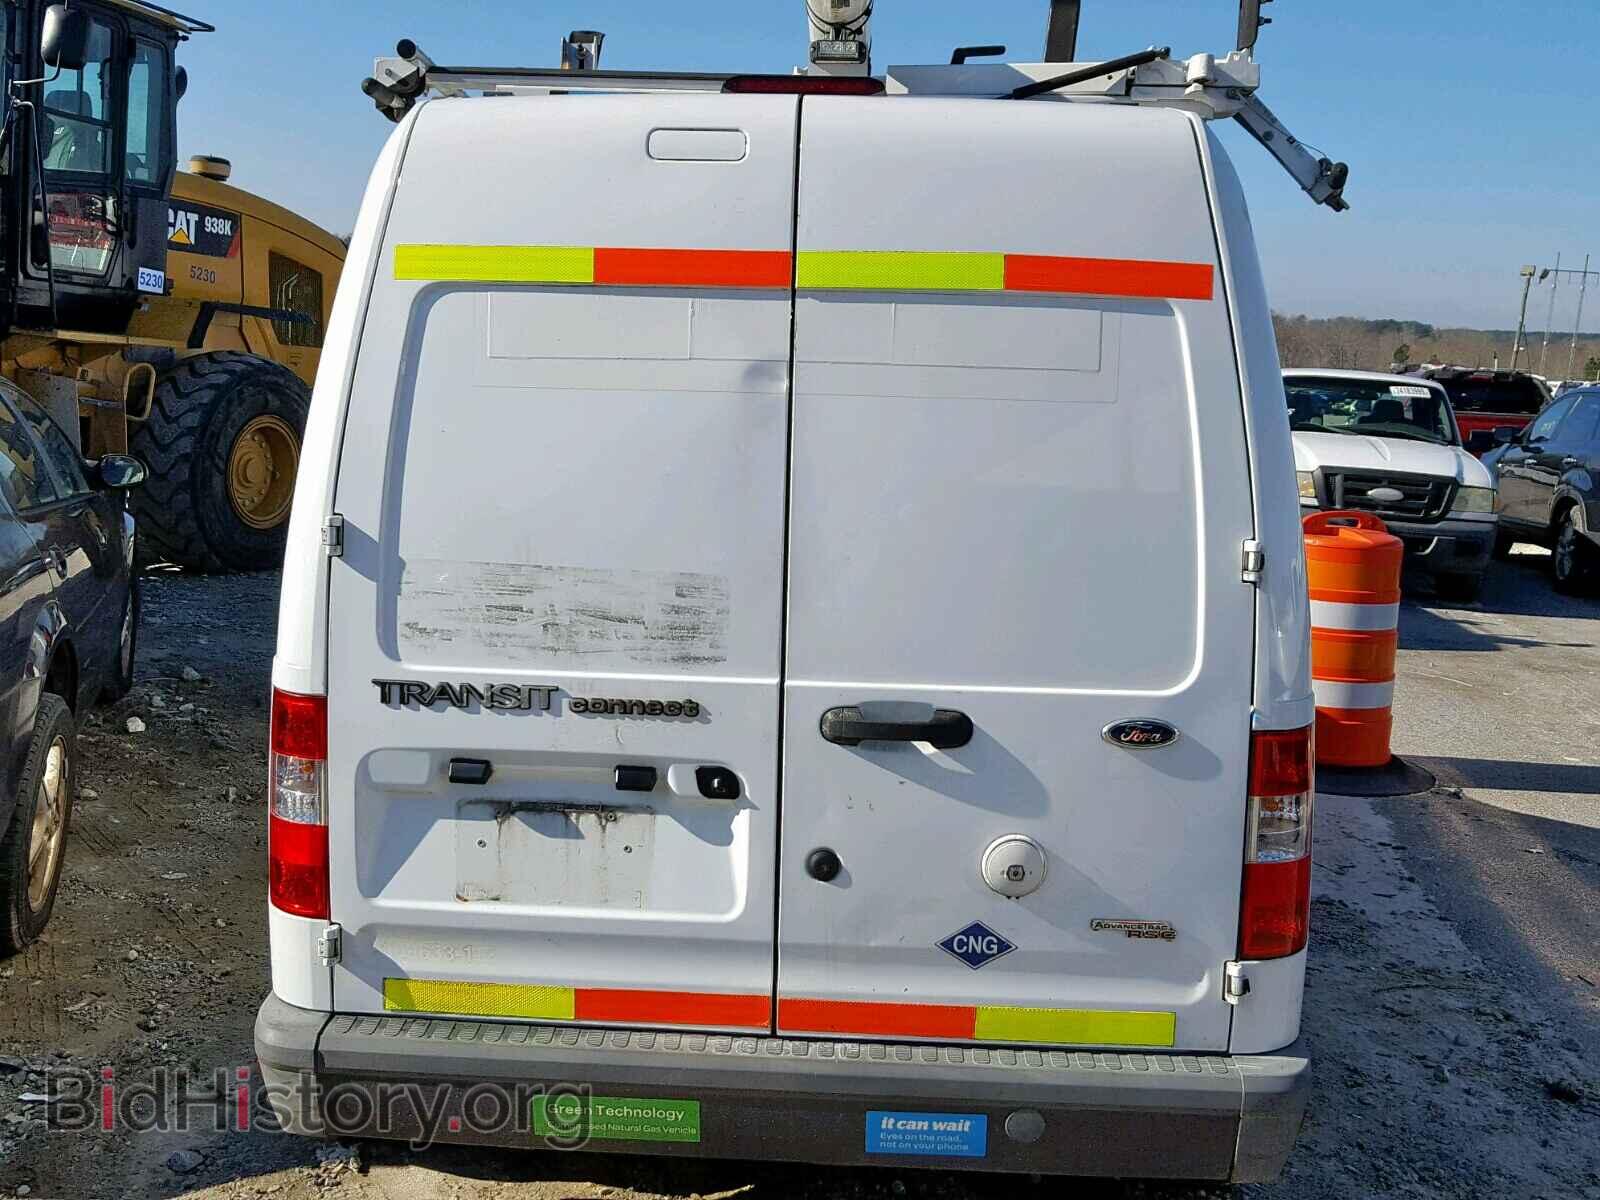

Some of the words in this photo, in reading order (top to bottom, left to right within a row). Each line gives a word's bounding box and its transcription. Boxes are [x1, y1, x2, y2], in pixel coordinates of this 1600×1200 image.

[204, 215, 232, 236] 938K
[139, 271, 163, 289] 5230
[190, 265, 216, 284] 5230
[371, 678, 559, 711] TRANSIT
[568, 696, 701, 718] connect
[1120, 726, 1162, 743] Ford
[953, 935, 998, 954] CNG
[547, 1103, 592, 1115] Green
[595, 1105, 685, 1121] Technology
[608, 1122, 641, 1132] Natural
[643, 1125, 660, 1133] Gas
[662, 1126, 697, 1135] Vehicle
[896, 1119, 929, 1131] can
[931, 1119, 971, 1133] wait
[880, 1132, 903, 1142] Eyes
[904, 1133, 918, 1141] on
[919, 1133, 935, 1141] the
